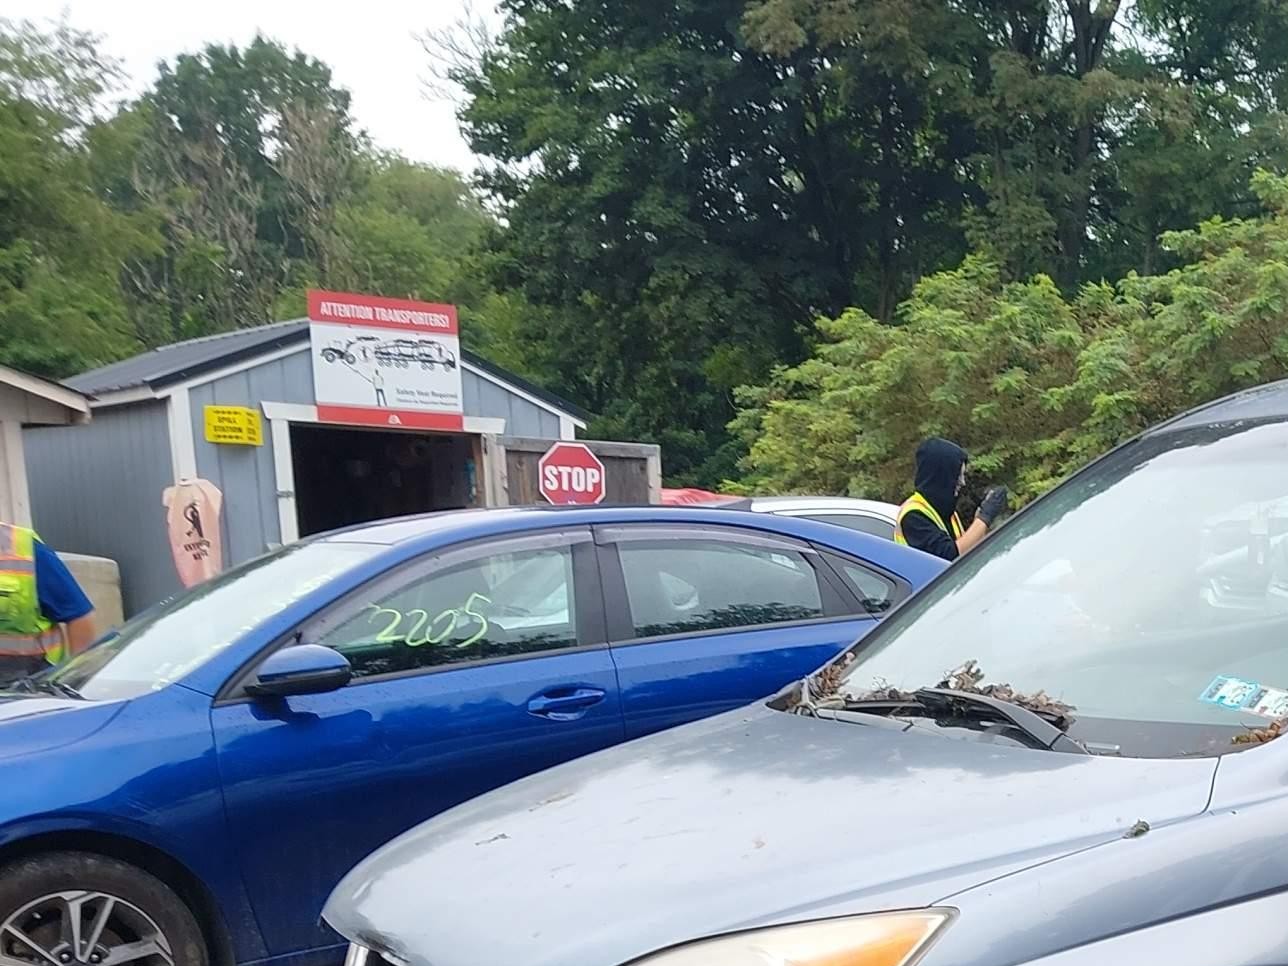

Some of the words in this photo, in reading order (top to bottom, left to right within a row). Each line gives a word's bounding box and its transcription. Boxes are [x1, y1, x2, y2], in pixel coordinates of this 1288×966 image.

[320, 301, 374, 320] ATTENTION
[374, 306, 450, 329] TRANSPORTERS!
[544, 464, 600, 493] STOP
[367, 591, 492, 648] 2205
